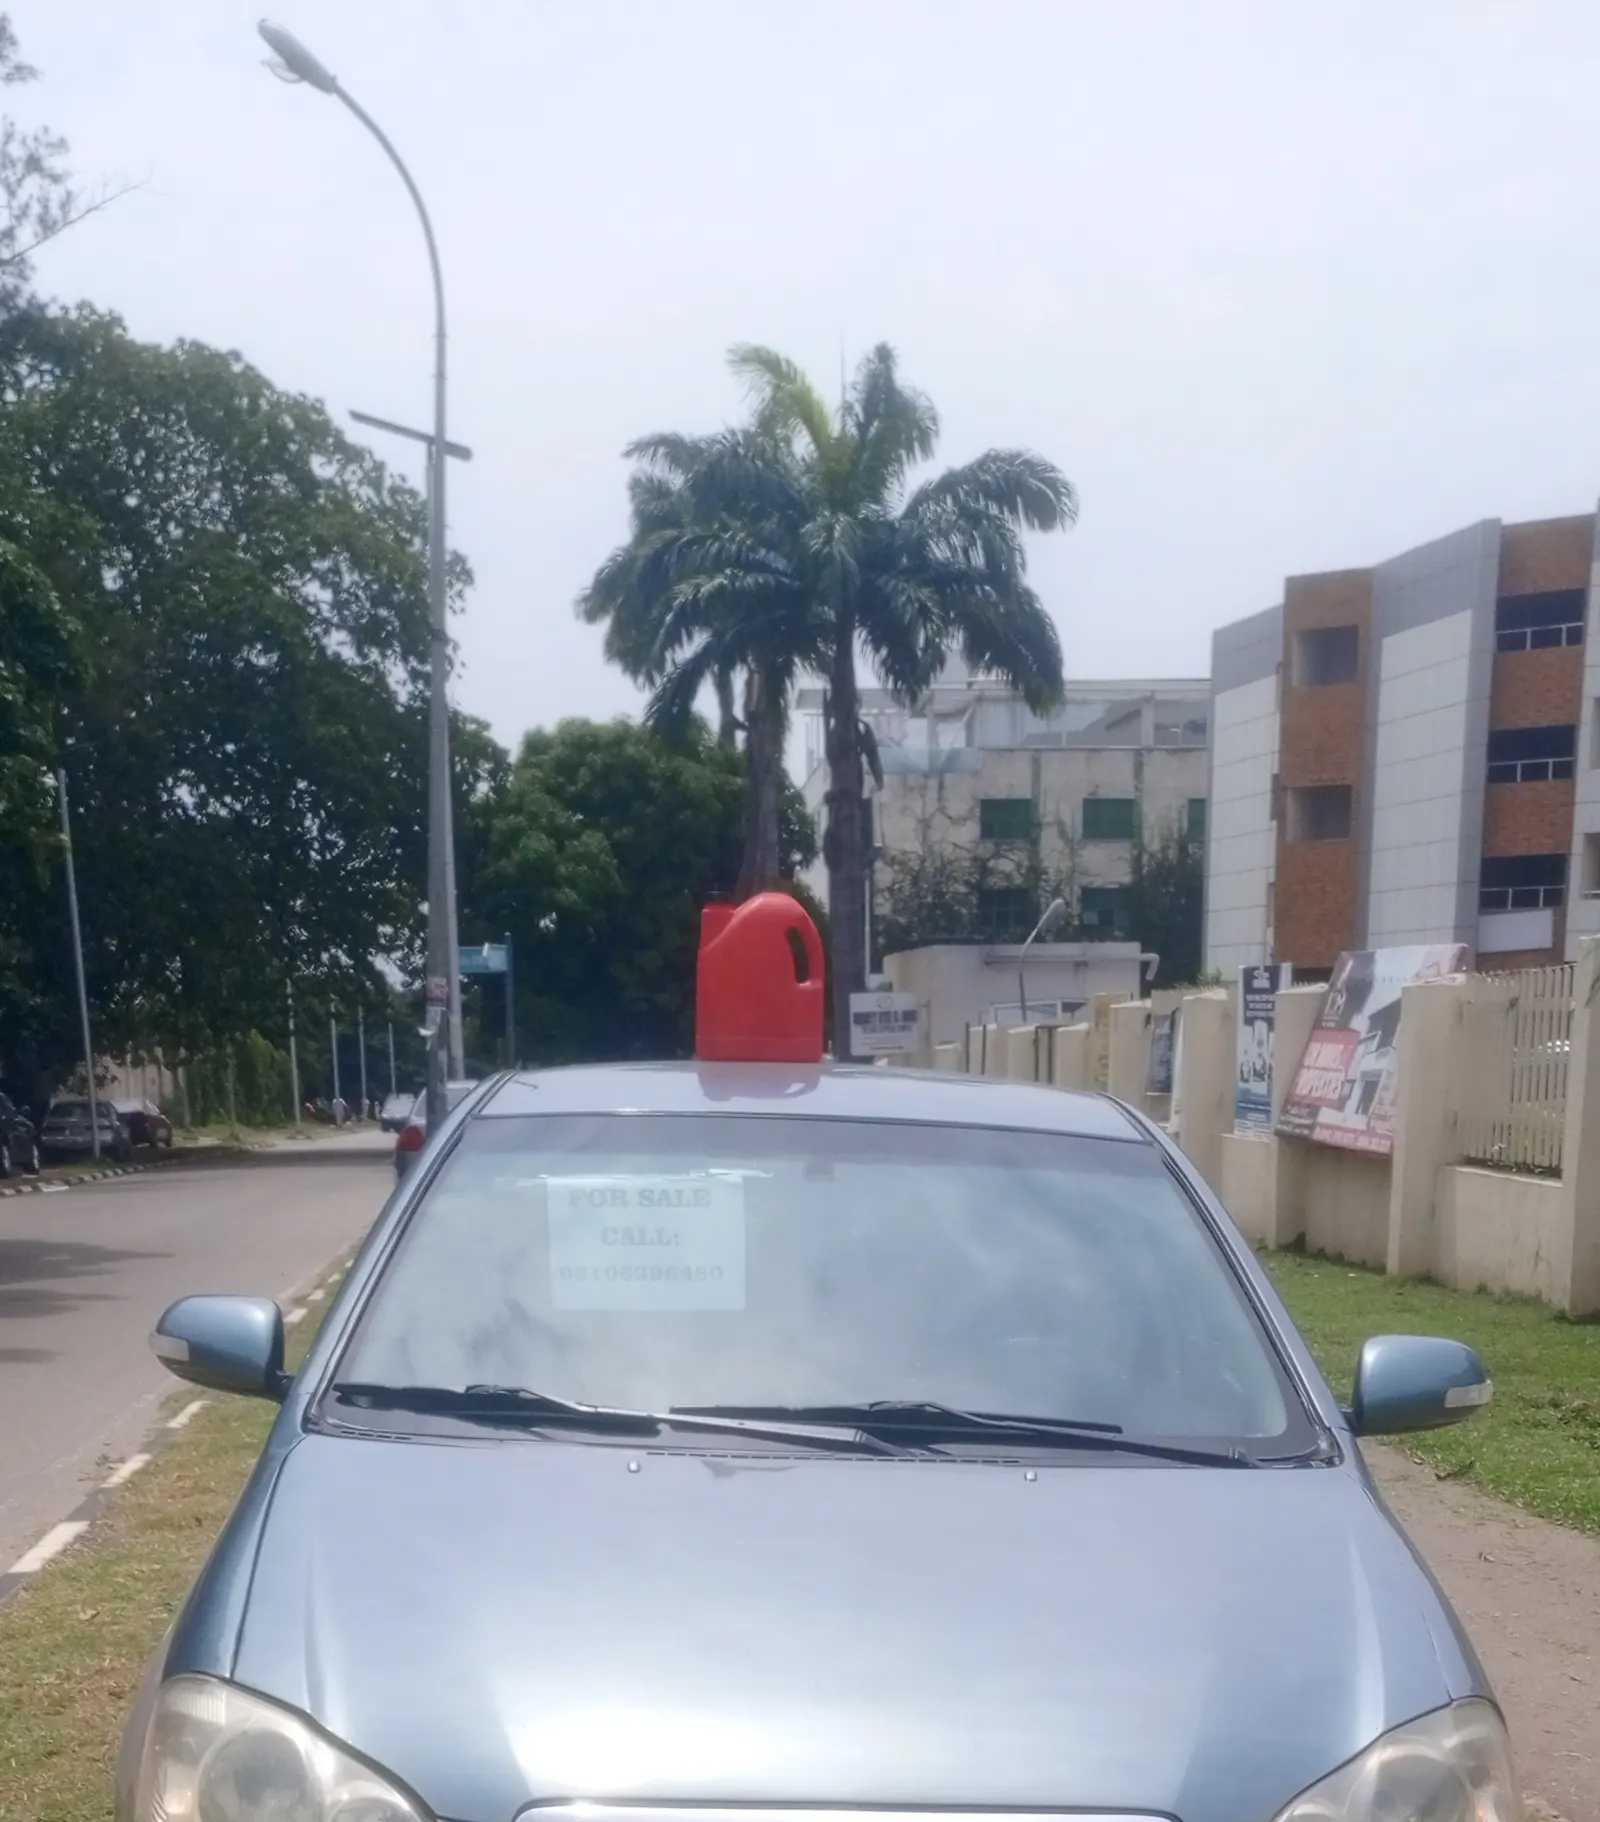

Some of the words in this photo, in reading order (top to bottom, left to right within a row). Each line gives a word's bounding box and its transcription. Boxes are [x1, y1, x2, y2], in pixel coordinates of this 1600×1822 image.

[568, 1188, 630, 1208] FOR
[637, 1188, 712, 1208] SALE
[600, 1226, 680, 1246] CALL:
